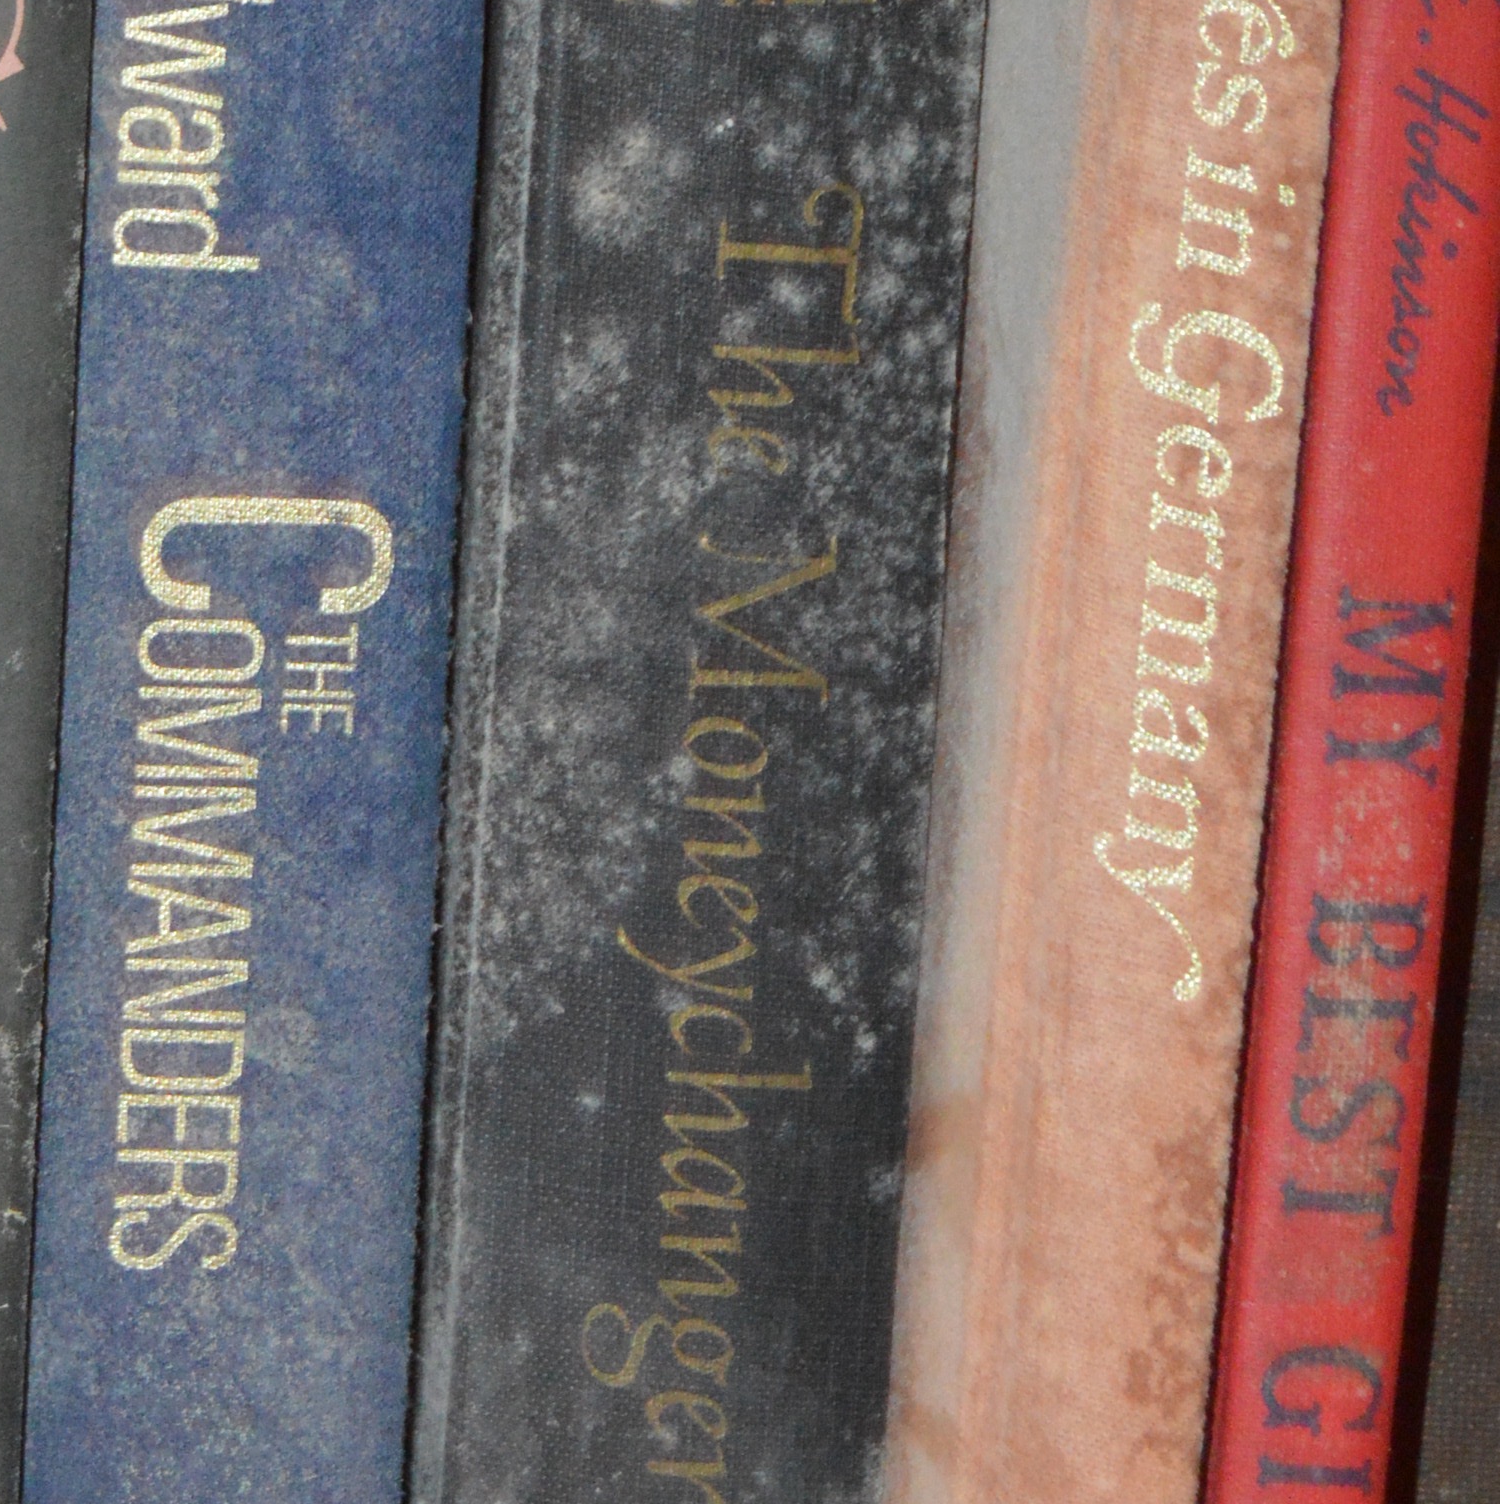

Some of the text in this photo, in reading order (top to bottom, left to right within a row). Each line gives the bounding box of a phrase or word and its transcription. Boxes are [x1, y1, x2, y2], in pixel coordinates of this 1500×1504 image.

[706, 182, 865, 477] The
[1176, 145, 1296, 271] in
[1375, 67, 1490, 417] Hokinson
[279, 624, 360, 737] THE
[1094, 302, 1284, 1001] Germany
[1325, 586, 1454, 787] MY
[108, 495, 395, 1272] COMMANDERS
[1282, 891, 1427, 1241] BEST
